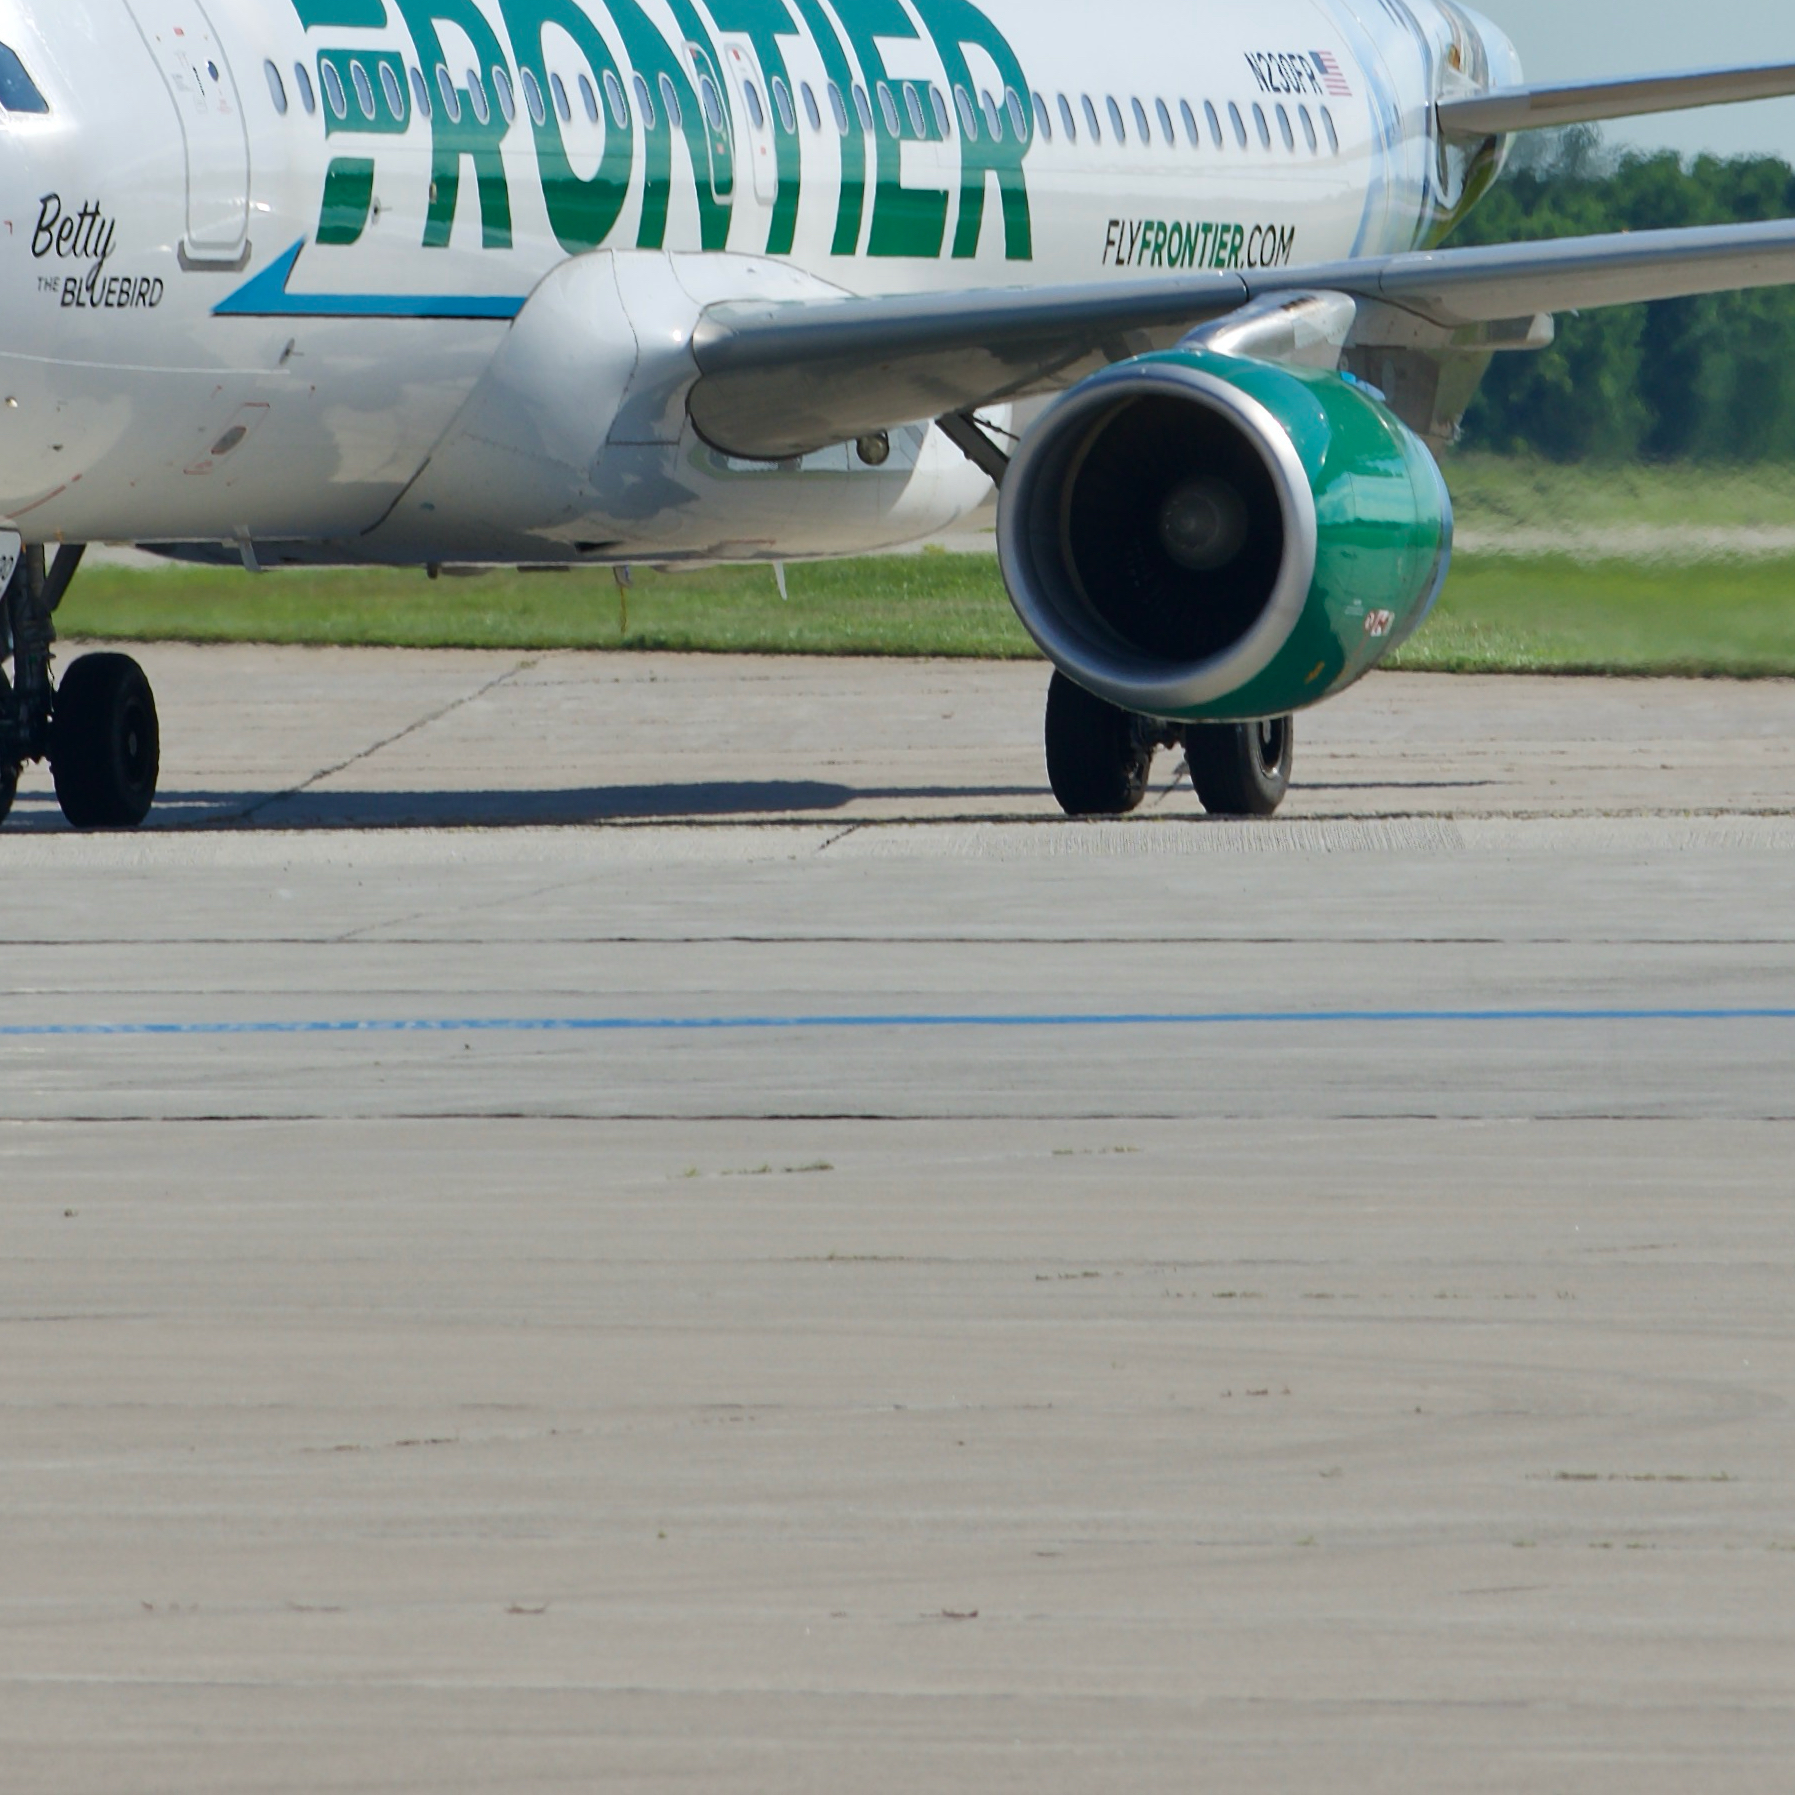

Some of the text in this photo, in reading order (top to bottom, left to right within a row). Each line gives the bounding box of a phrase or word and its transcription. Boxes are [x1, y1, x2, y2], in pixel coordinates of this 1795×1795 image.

[1243, 51, 1323, 94] N230FR
[31, 192, 116, 292] Betty
[1102, 219, 1296, 269] FLYFRONTIER.COM
[37, 276, 164, 308] THE BLUEBIRD
